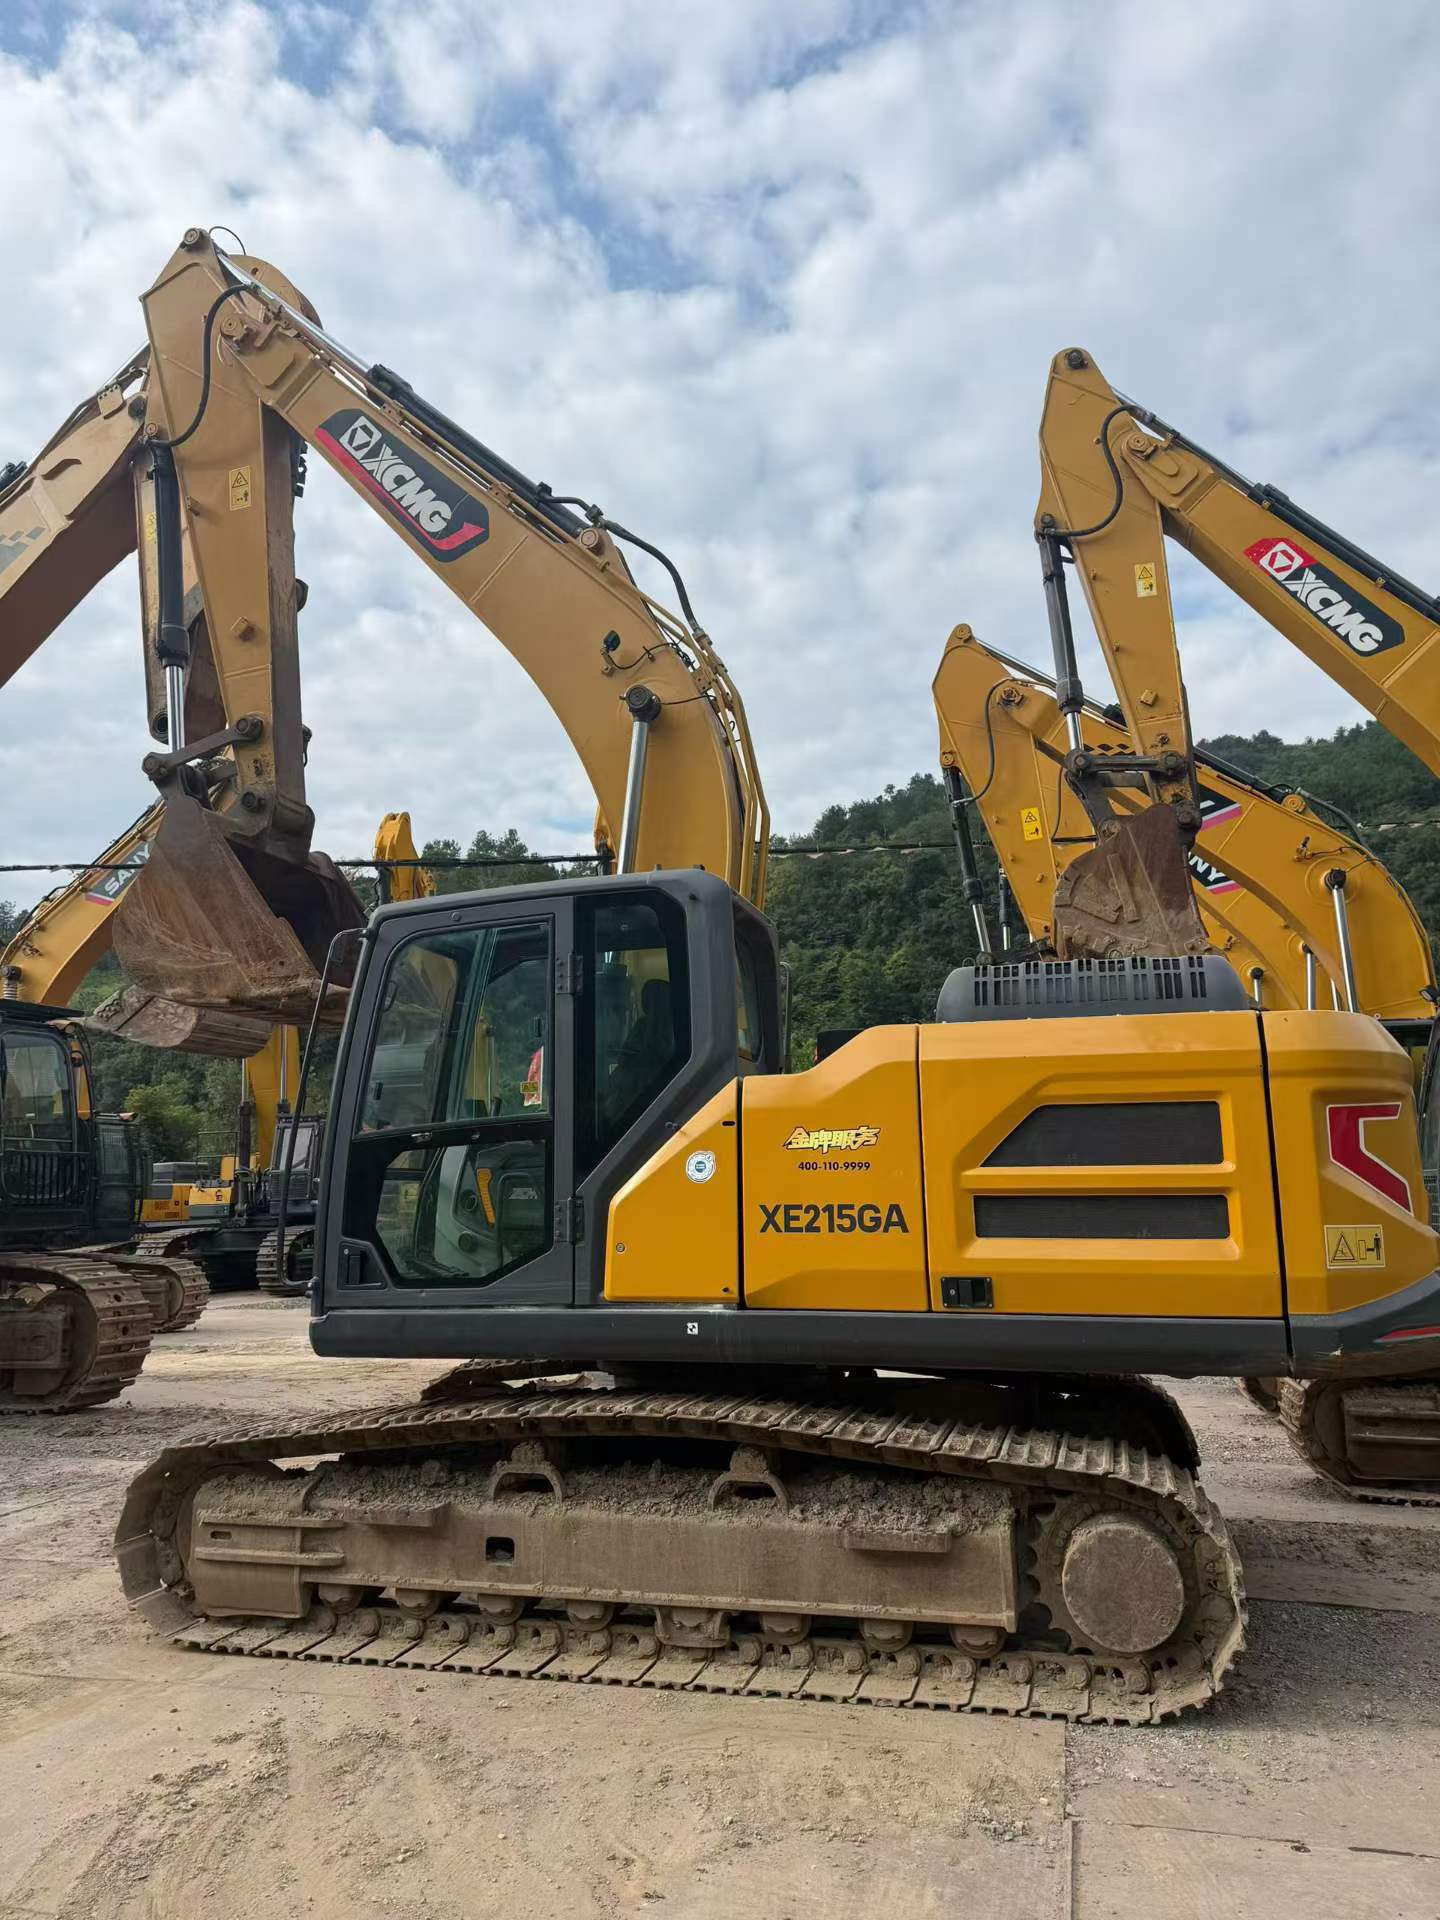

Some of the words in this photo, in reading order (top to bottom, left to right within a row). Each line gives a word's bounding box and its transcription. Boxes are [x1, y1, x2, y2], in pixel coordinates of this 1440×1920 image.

[360, 443, 452, 533] XCMG
[1282, 568, 1383, 652] XCMG
[1187, 852, 1227, 882] NY
[798, 1161, 871, 1172] 400-110-9999
[759, 1203, 910, 1233] XE215GA
